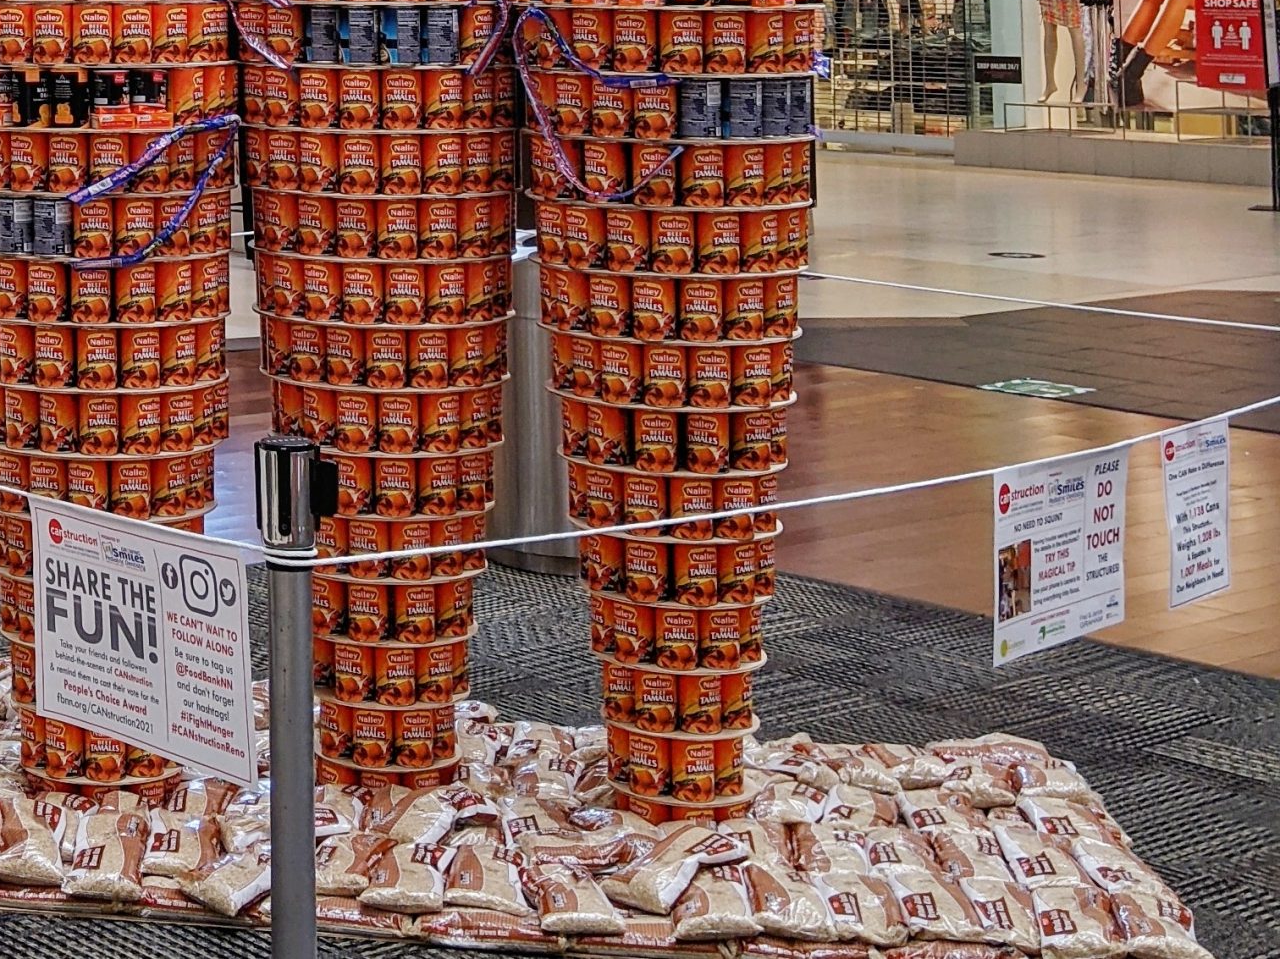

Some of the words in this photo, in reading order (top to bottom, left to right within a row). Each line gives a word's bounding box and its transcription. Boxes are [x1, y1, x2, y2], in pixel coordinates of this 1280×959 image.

[661, 219, 688, 230] Nalley
[659, 235, 690, 245] TAMALES
[91, 402, 116, 411] Nalley
[89, 417, 118, 426] TAMALES
[1094, 459, 1120, 476] PLEASE
[1057, 480, 1085, 496] Smiles
[1096, 479, 1113, 499] DO
[1093, 503, 1115, 524] NOT
[1086, 526, 1120, 551] TOUCH
[112, 547, 145, 564] Smiles
[1097, 552, 1108, 563] THE
[45, 557, 112, 601] SHARE
[117, 576, 156, 614] THE
[45, 587, 159, 665] FUN!
[166, 610, 178, 624] WE
[180, 615, 204, 632] CAN'T
[205, 622, 224, 638] WAIT
[226, 629, 238, 643] TO
[171, 628, 204, 647] FOLLOW
[206, 639, 234, 657] ALONG
[55, 650, 105, 673] behind-the-scenes
[106, 666, 113, 675] of
[114, 668, 153, 688] CANstruction
[60, 639, 73, 650] Take
[75, 645, 86, 653] your
[88, 647, 108, 661] friends
[109, 656, 120, 665] and
[121, 658, 148, 674] followers
[174, 646, 184, 659] Be
[185, 652, 200, 664] sure
[201, 655, 209, 667] to
[211, 659, 223, 674] tag
[226, 665, 233, 675] us
[50, 662, 55, 671] &
[56, 666, 76, 678] remind
[77, 671, 91, 682] them
[92, 676, 98, 684] to
[100, 679, 111, 688] cast
[112, 681, 125, 692] their
[127, 687, 139, 697] vote
[140, 691, 149, 701] for
[150, 695, 160, 705] the
[176, 662, 233, 691] @FoodBankNN
[63, 678, 93, 698] People's
[95, 689, 120, 707] Choice
[122, 699, 147, 716] Award
[177, 681, 191, 692] and
[193, 684, 210, 698] don't
[212, 692, 234, 708] forget
[183, 698, 194, 709] our
[196, 700, 230, 722] hashtags!
[358, 714, 383, 725] Nalley
[180, 710, 234, 738] #iFightHunger
[356, 730, 386, 739] TAMALES
[171, 723, 245, 759] #CANstructionReno
